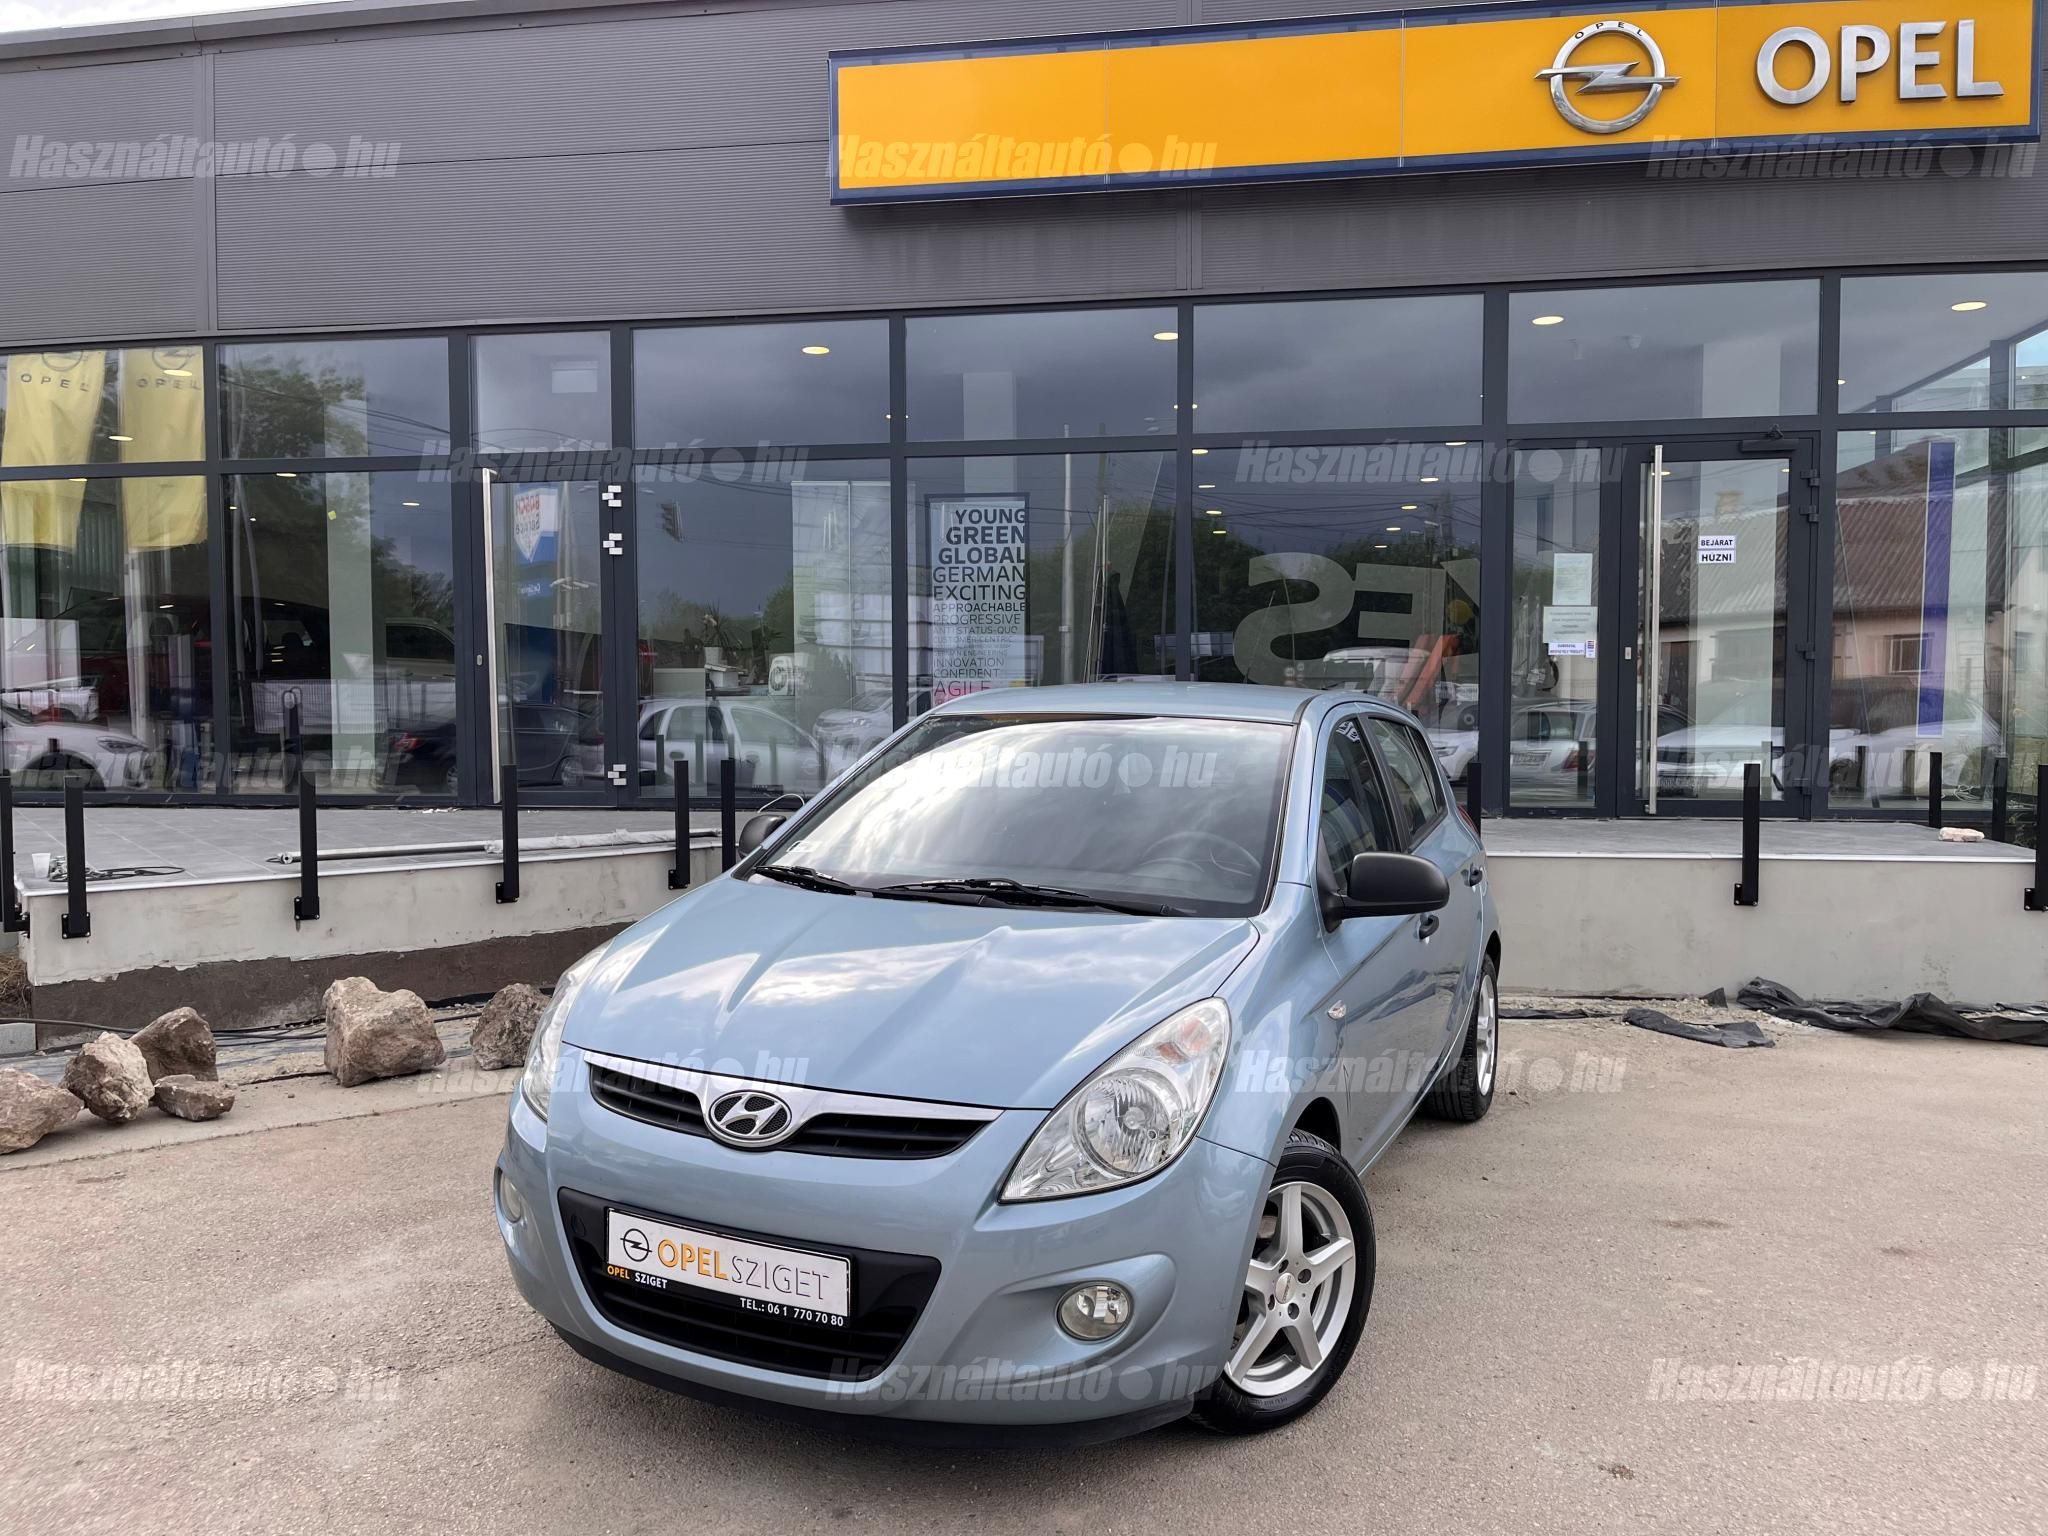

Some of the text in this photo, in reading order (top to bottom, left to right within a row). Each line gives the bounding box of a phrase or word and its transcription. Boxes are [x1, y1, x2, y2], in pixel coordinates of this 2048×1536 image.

[1575, 21, 1644, 40] OPEL
[1756, 19, 2005, 105] OPEL
[955, 508, 1026, 525] YOUNG
[945, 525, 1025, 545] GREEN
[1700, 539, 1734, 547] BEJÁRAT
[938, 546, 1025, 565] GLOBAL
[932, 565, 1025, 583] GERMAN
[933, 584, 1026, 601] EXCITING
[933, 602, 1026, 613] APPROACHABLE
[933, 613, 1021, 625] PROGRESSIVE
[933, 658, 1004, 667] INNOVATION
[933, 668, 1000, 679] CONFIDENT
[607, 1264, 668, 1289] OPEL SZIGET
[740, 1297, 765, 1312] TEL.:
[767, 1303, 780, 1315] 06
[793, 1308, 812, 1321] 770
[815, 1312, 828, 1324] 70
[830, 1316, 844, 1327] 80
